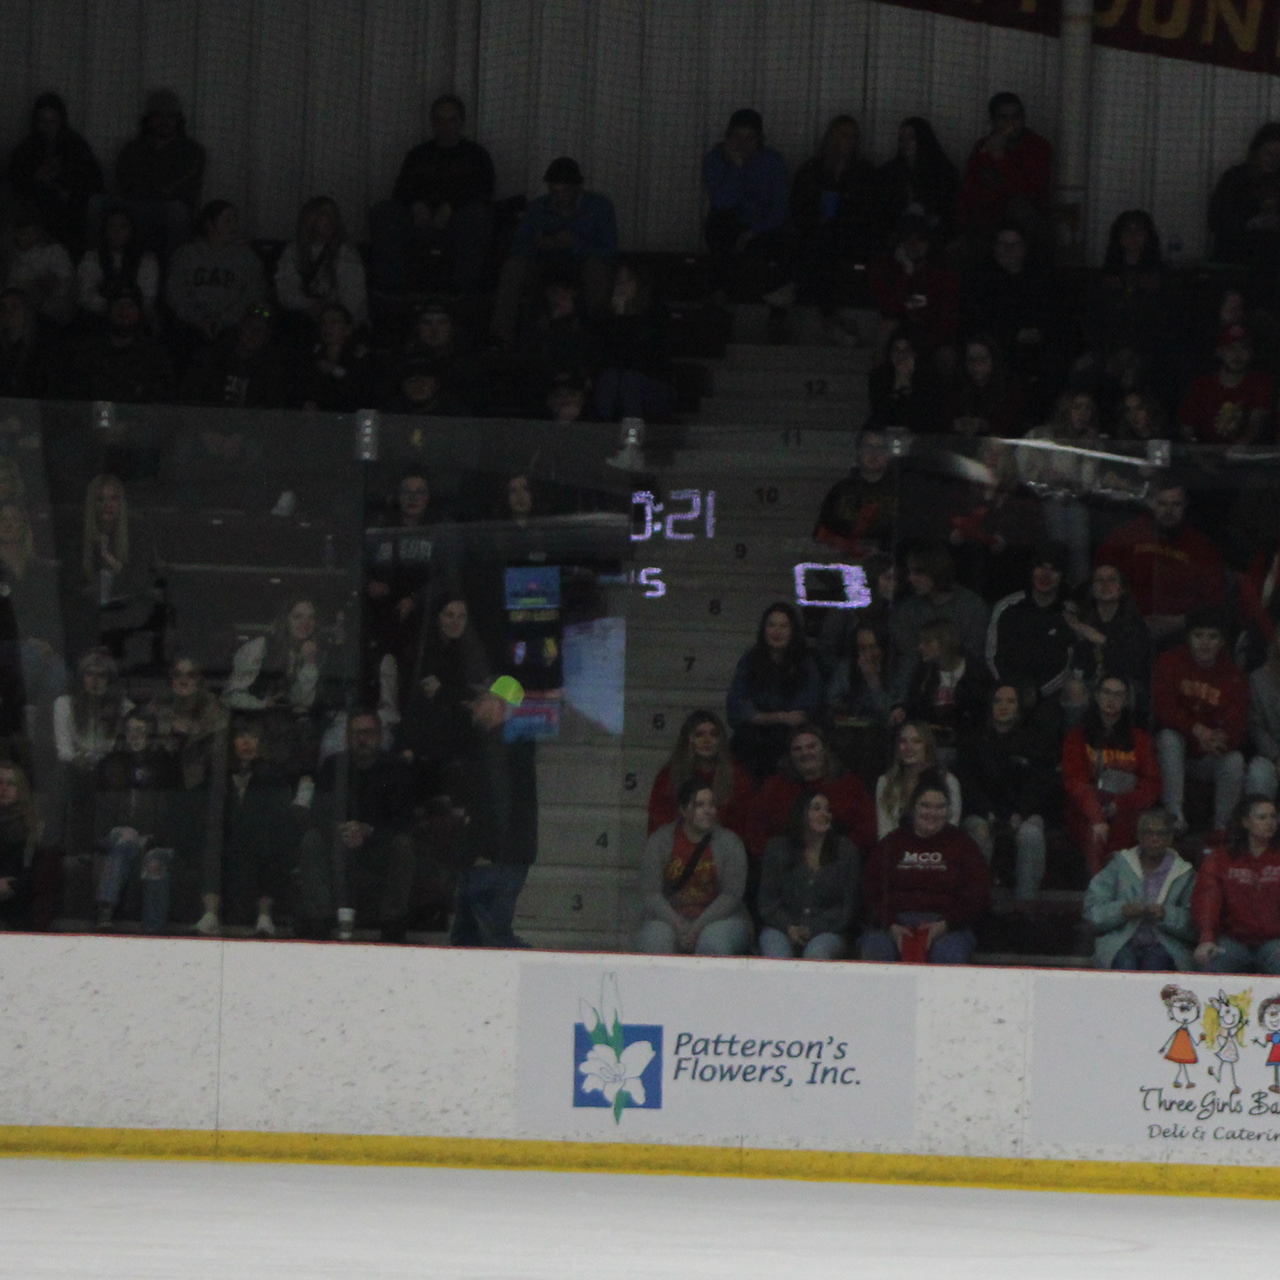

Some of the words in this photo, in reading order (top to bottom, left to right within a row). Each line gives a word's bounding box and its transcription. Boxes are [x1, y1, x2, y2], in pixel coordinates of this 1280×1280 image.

[684, 656, 696, 672] 7
[653, 713, 665, 729] 6
[624, 772, 637, 790] 5
[596, 832, 608, 848] 4
[903, 851, 943, 863] MCO
[571, 894, 583, 911] 3
[673, 1032, 849, 1060] Patterson's
[673, 1057, 794, 1088] Flowers,
[806, 1061, 861, 1086] Inc.
[1140, 1085, 1197, 1113] Three
[1197, 1090, 1244, 1121] Girls
[1149, 1123, 1190, 1139] Deli
